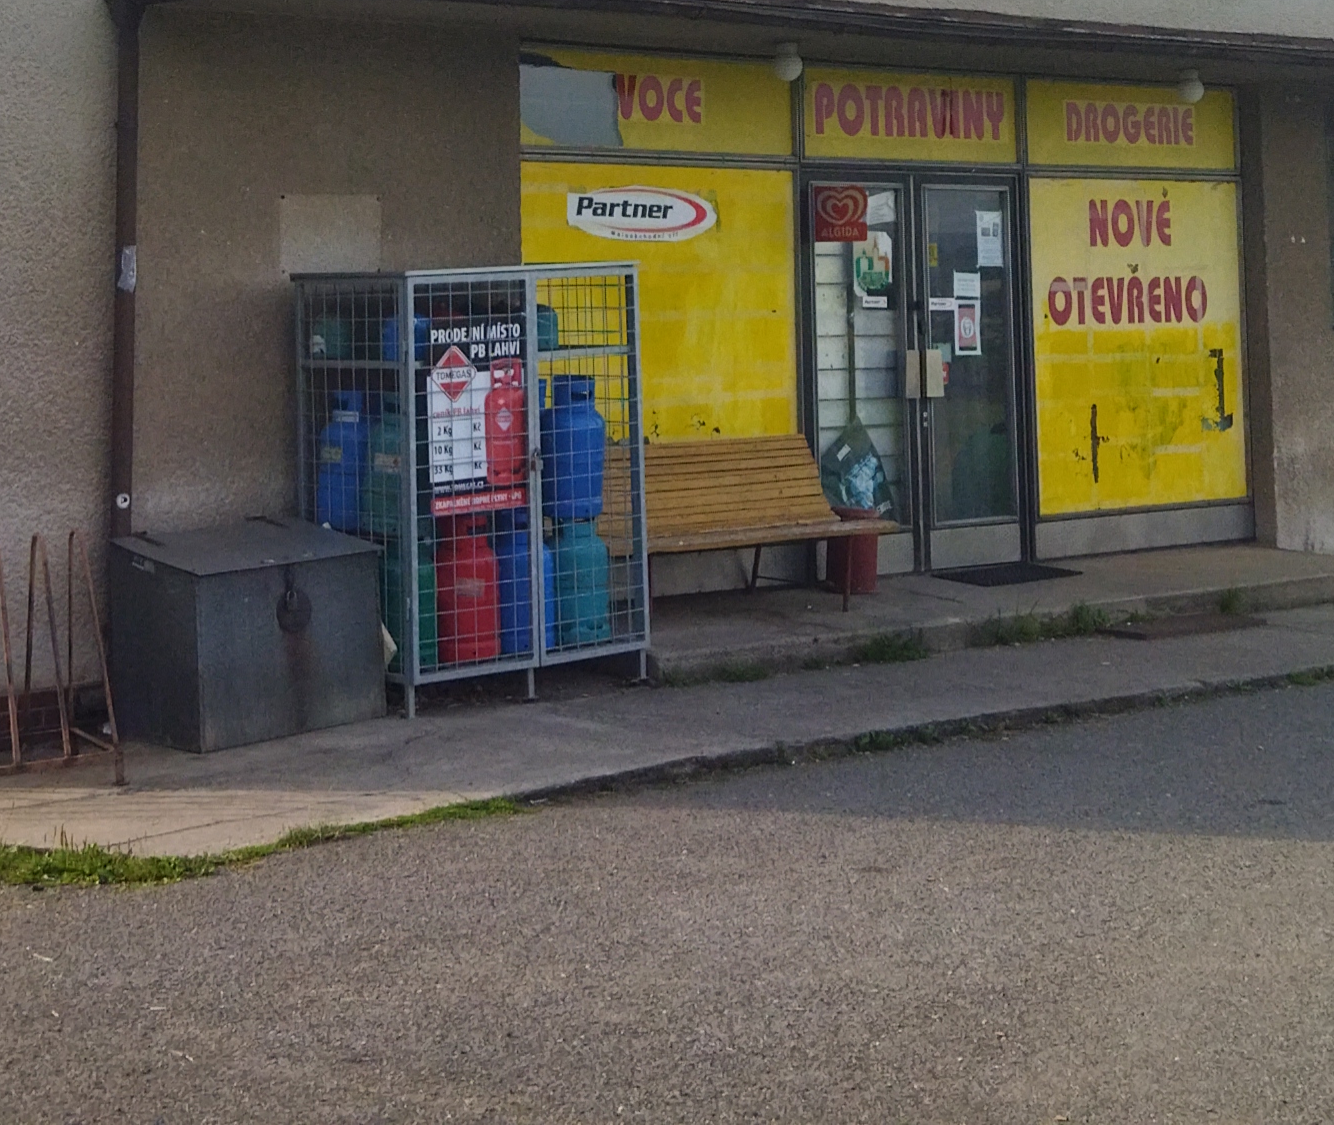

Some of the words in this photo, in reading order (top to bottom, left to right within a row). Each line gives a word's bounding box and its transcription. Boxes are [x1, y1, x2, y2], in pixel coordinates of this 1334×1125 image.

[616, 74, 702, 124] VOCE
[814, 83, 1004, 141] POTRAVINY
[1066, 101, 1194, 146] DROGERIE
[575, 196, 673, 220] Partner
[1089, 186, 1172, 248] NOVÉ
[821, 226, 860, 237] ALGIDA
[1047, 263, 1208, 327] OTEVŘENO
[431, 323, 485, 344] PRODEJNÍ
[487, 321, 521, 339] MÍSTO
[471, 344, 486, 358] PB
[489, 340, 520, 357] LAHVÍ
[437, 426, 442, 436] 2
[443, 425, 453, 437] Kg
[434, 445, 443, 455] 10
[444, 444, 453, 456] Kg
[434, 465, 443, 475] 33
